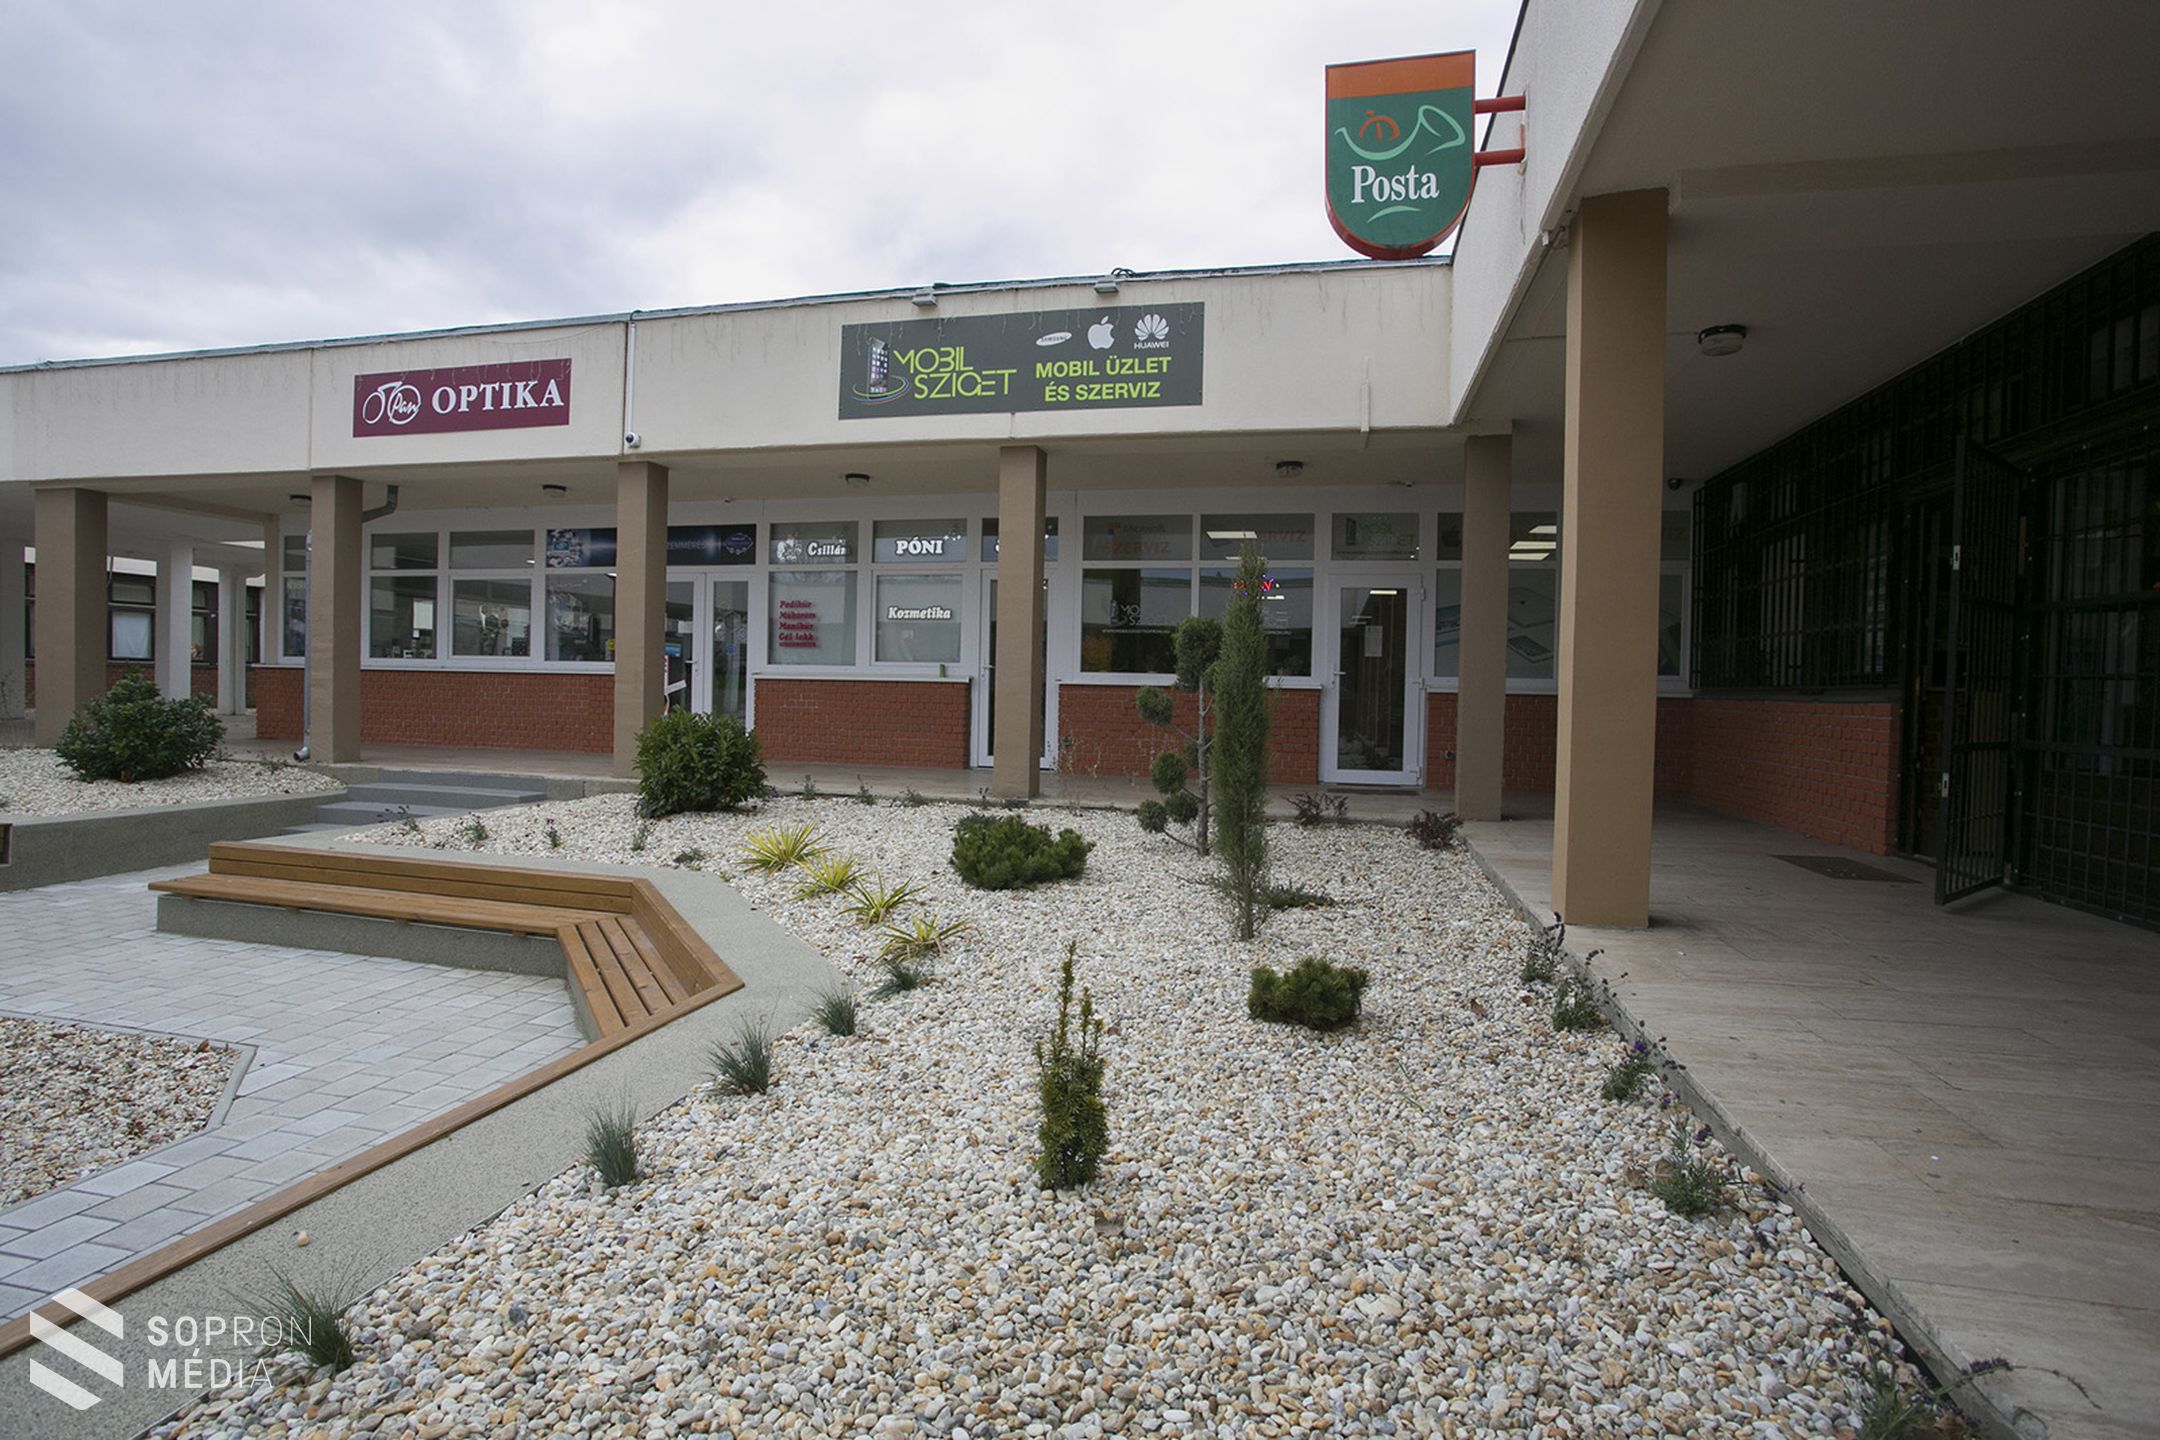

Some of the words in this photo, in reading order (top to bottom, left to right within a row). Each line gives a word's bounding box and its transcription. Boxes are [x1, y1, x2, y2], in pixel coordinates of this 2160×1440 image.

[1351, 164, 1440, 203] Posta
[1133, 341, 1169, 350] HUAWEI
[893, 346, 974, 375] MOBIL
[1035, 360, 1100, 379] MOBIL
[1105, 355, 1172, 376] ÜZLET
[913, 368, 1018, 400] SZIGET
[1044, 381, 1070, 402] ÉS
[1075, 381, 1161, 401] SZERVIZ
[431, 379, 564, 415] OPTIKA
[895, 537, 944, 555] PÓNI
[887, 607, 952, 619] Kozmetika
